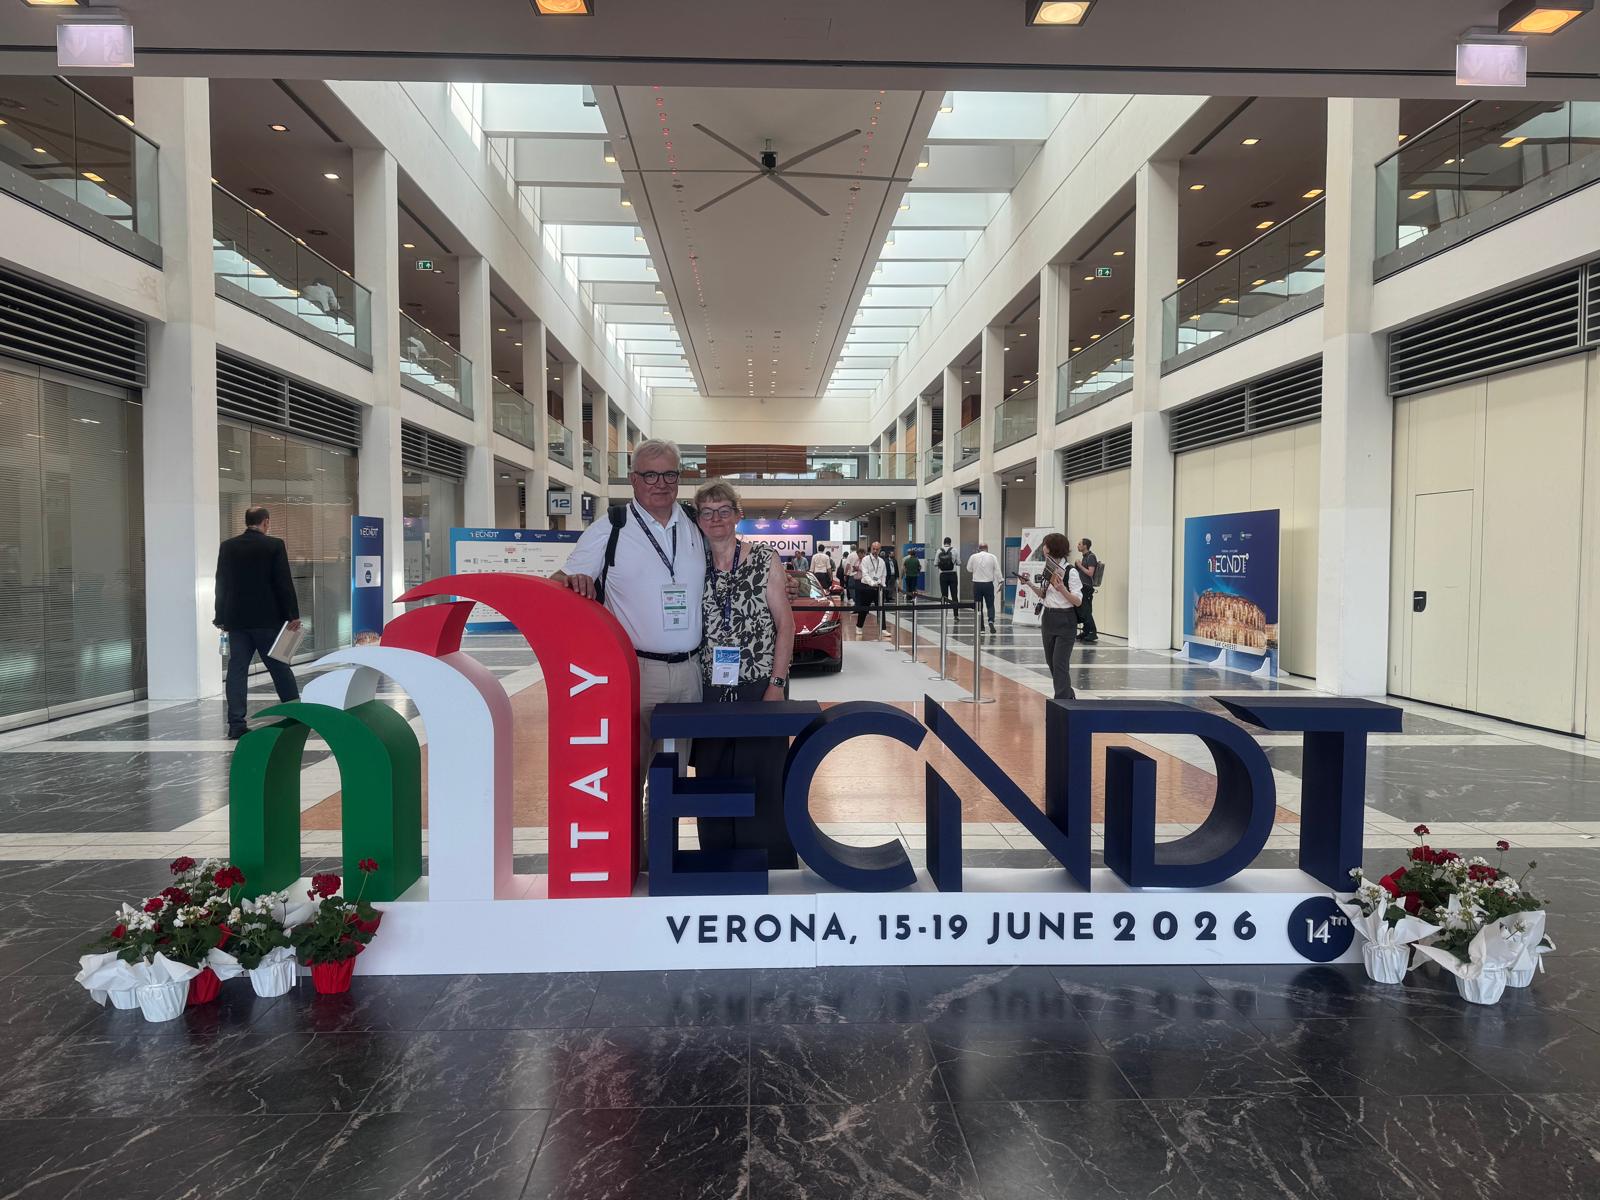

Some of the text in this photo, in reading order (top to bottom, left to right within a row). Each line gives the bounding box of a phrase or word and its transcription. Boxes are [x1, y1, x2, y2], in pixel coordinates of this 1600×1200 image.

[551, 499, 570, 508] 12
[583, 496, 592, 510] T
[960, 501, 977, 511] 11
[749, 540, 808, 551] POINT
[569, 663, 609, 882] ITALY
[649, 694, 1403, 896] ECNDT
[666, 910, 1257, 945] VERONA, 15-19 JUNE 2026
